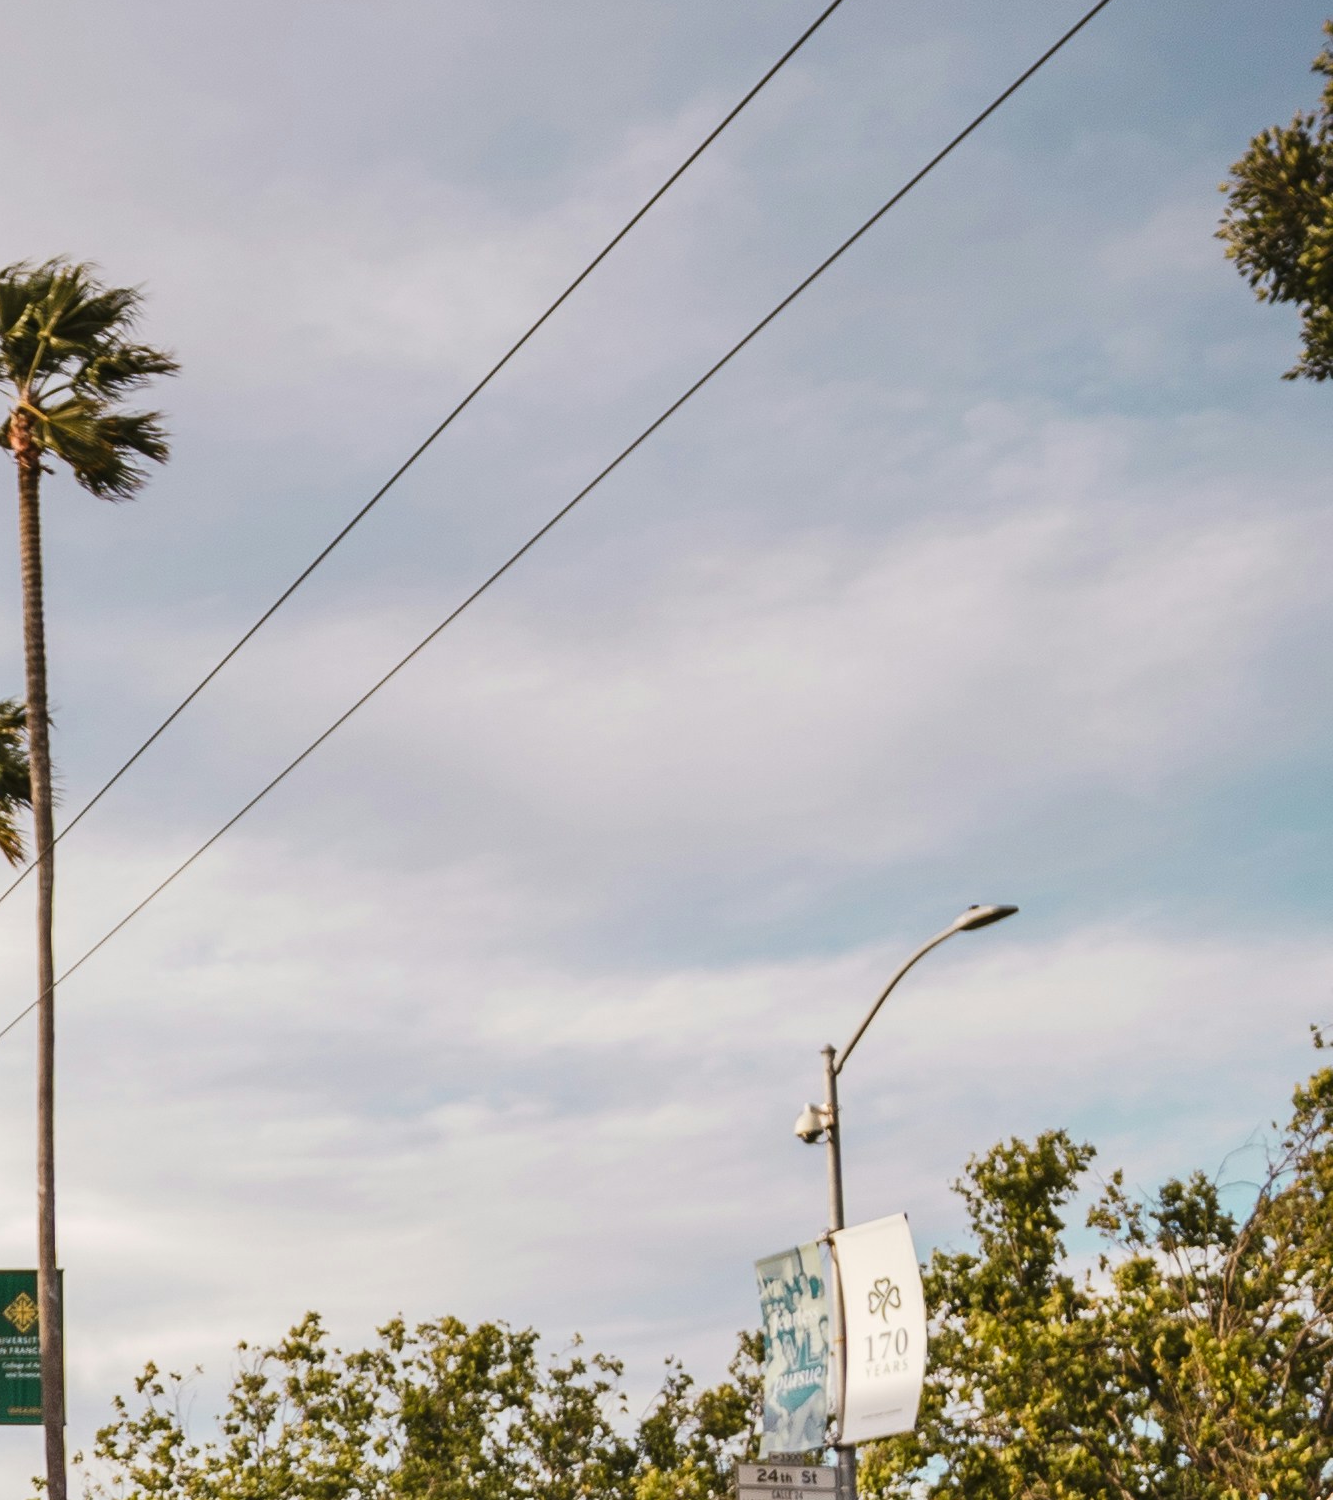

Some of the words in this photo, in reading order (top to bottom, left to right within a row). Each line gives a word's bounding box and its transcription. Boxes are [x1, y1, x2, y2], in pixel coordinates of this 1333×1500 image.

[864, 1326, 909, 1363] 170
[865, 1359, 909, 1379] YEARS
[756, 1468, 793, 1483] 24th
[801, 1470, 818, 1485] St
